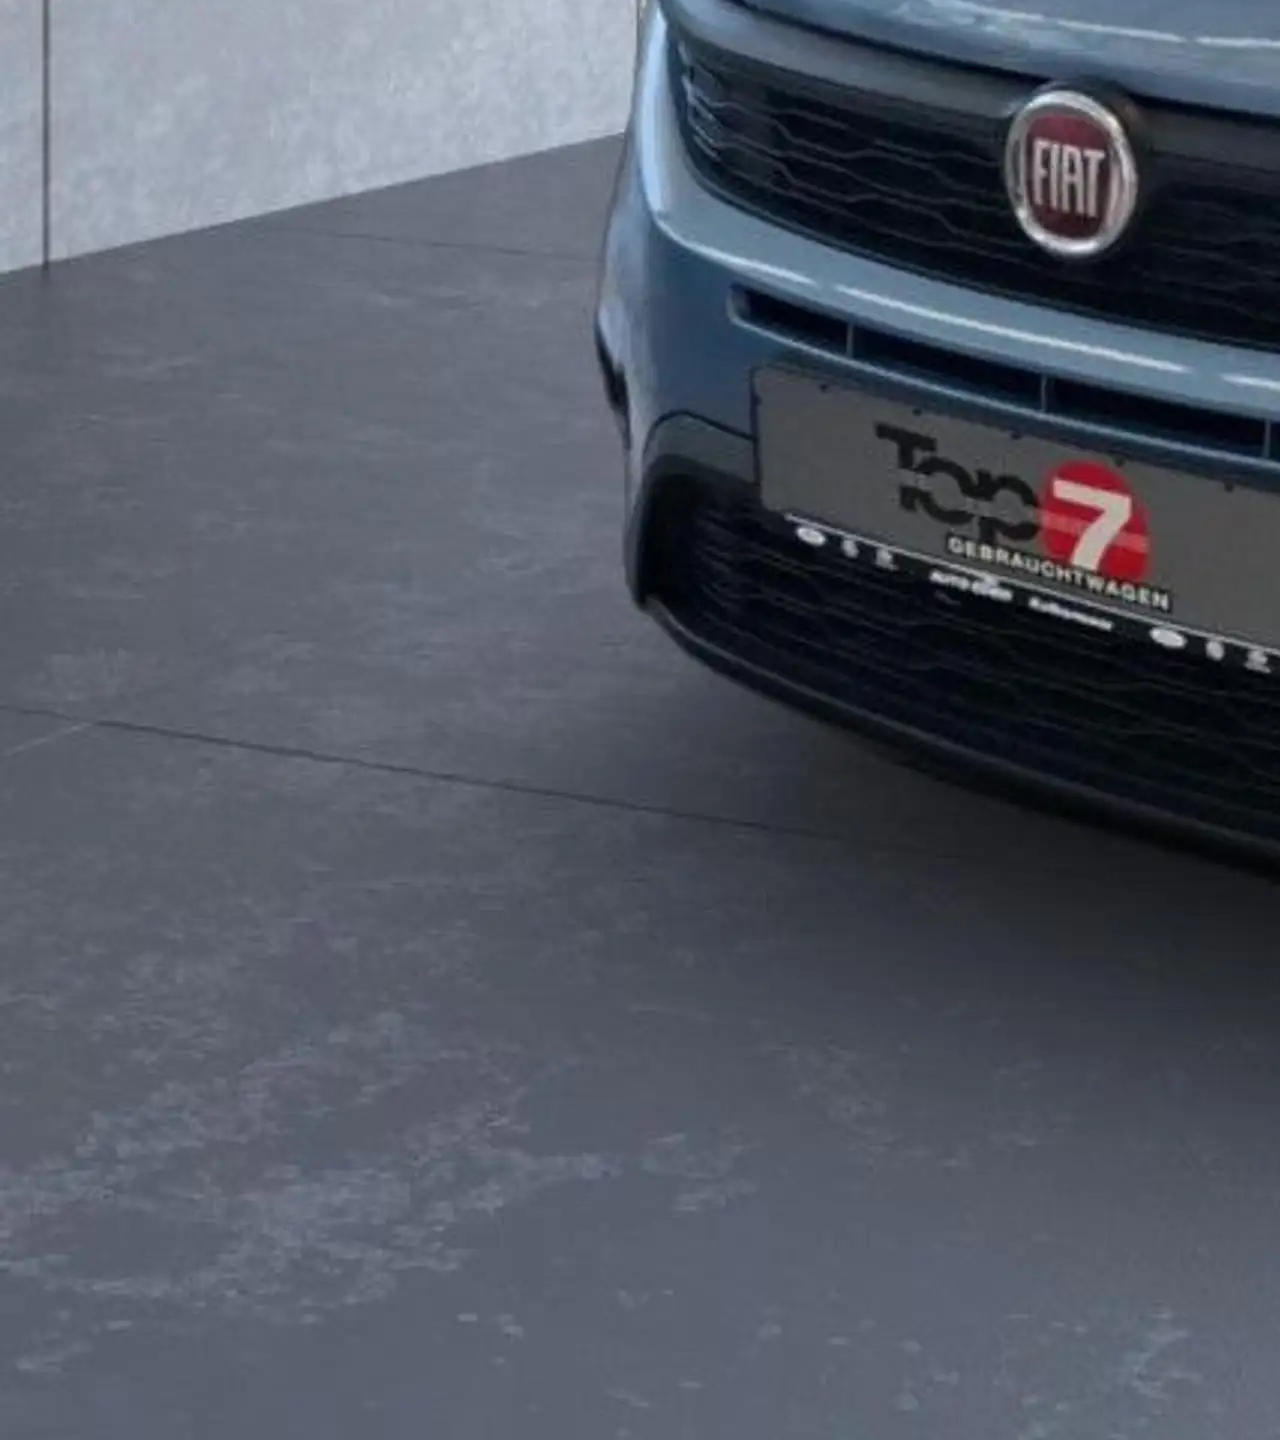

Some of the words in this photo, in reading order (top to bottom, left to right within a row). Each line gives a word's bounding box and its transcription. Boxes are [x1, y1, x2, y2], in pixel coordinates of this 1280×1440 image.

[1032, 136, 1105, 218] FIAT
[1053, 477, 1132, 570] 7
[948, 535, 1169, 611] GEBRAUCHTWAGEN
